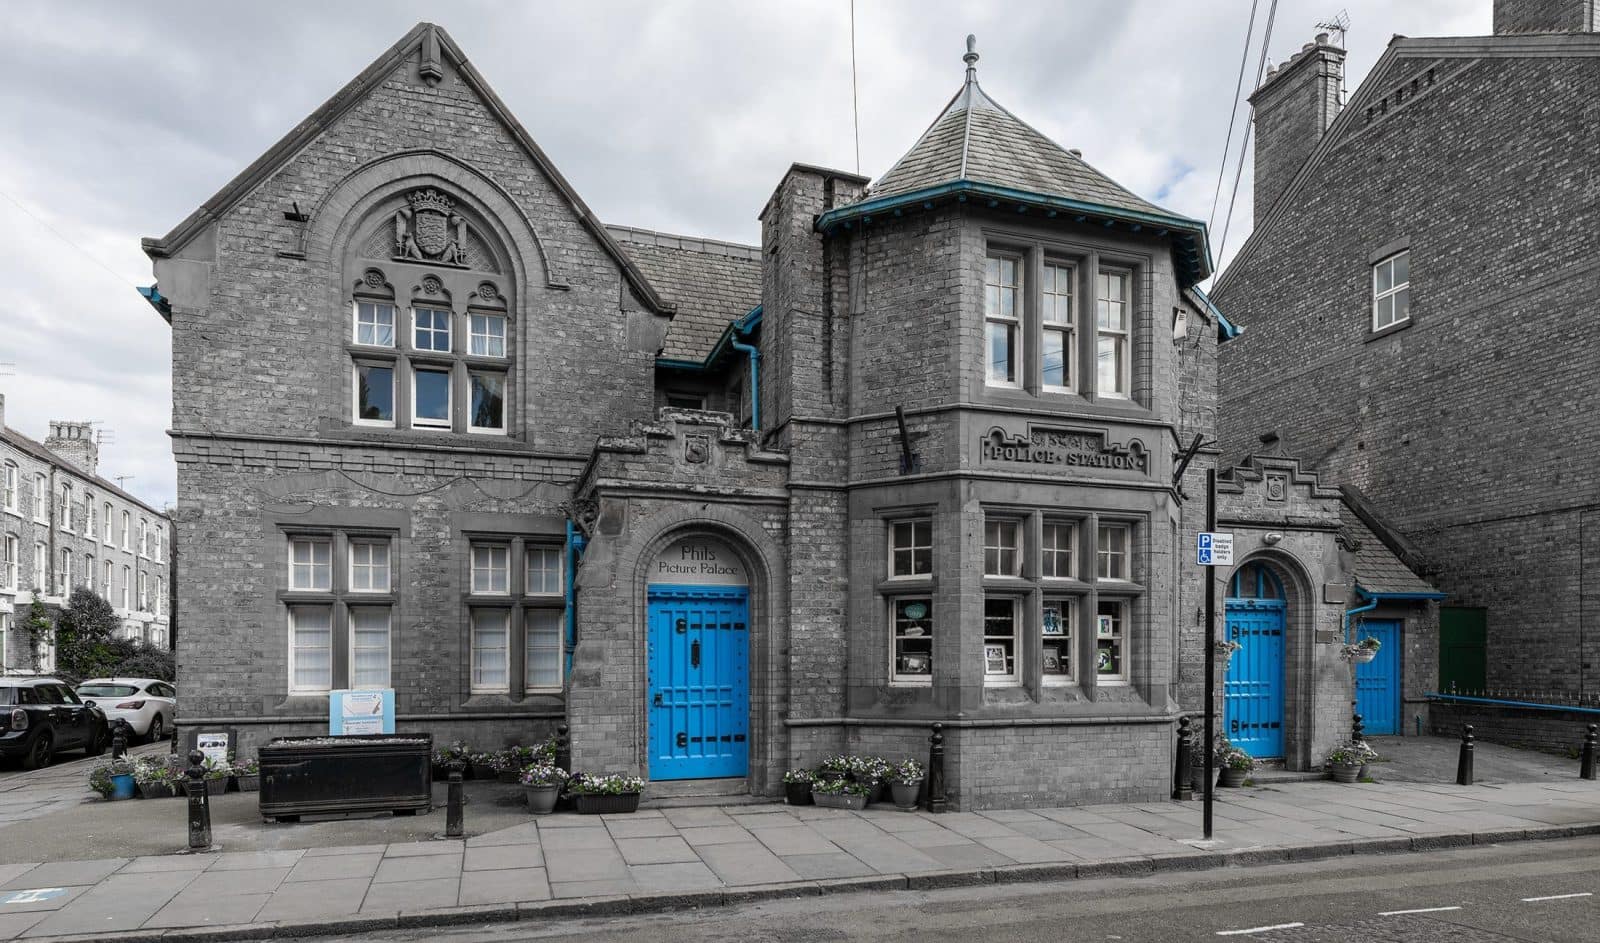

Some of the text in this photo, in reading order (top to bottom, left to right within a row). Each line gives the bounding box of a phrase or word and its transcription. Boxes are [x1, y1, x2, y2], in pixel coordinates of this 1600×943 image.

[992, 446, 1136, 470] POLICE STATION
[1201, 535, 1210, 547] P
[681, 545, 716, 561] Phils
[658, 561, 738, 576] Picture Palace
